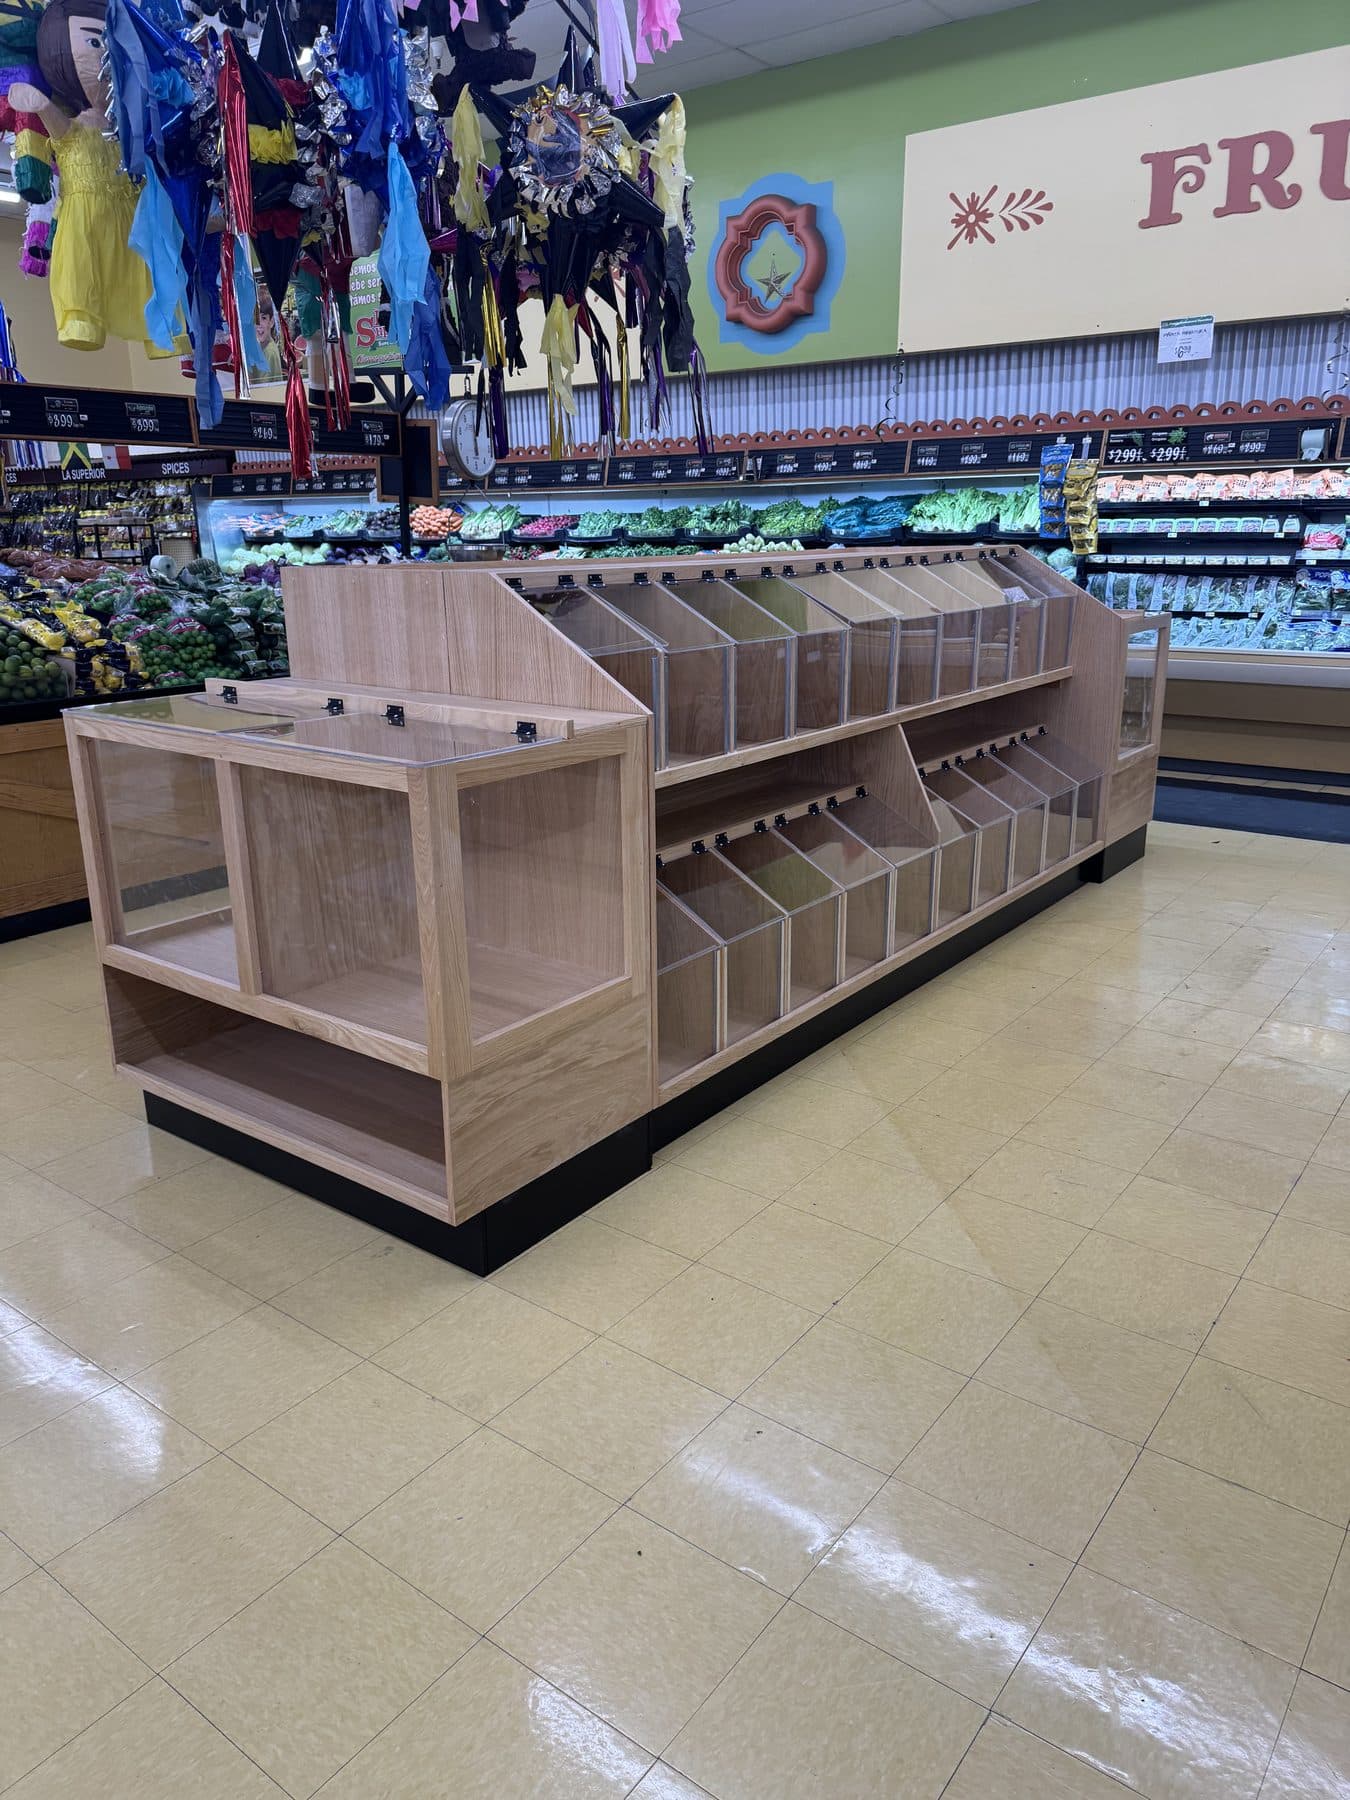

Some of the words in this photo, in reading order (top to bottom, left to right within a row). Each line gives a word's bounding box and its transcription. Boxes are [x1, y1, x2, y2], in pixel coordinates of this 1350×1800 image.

[61, 470, 71, 481] LA
[72, 468, 106, 480] SUPERIOR
[161, 462, 190, 475] SPICES
